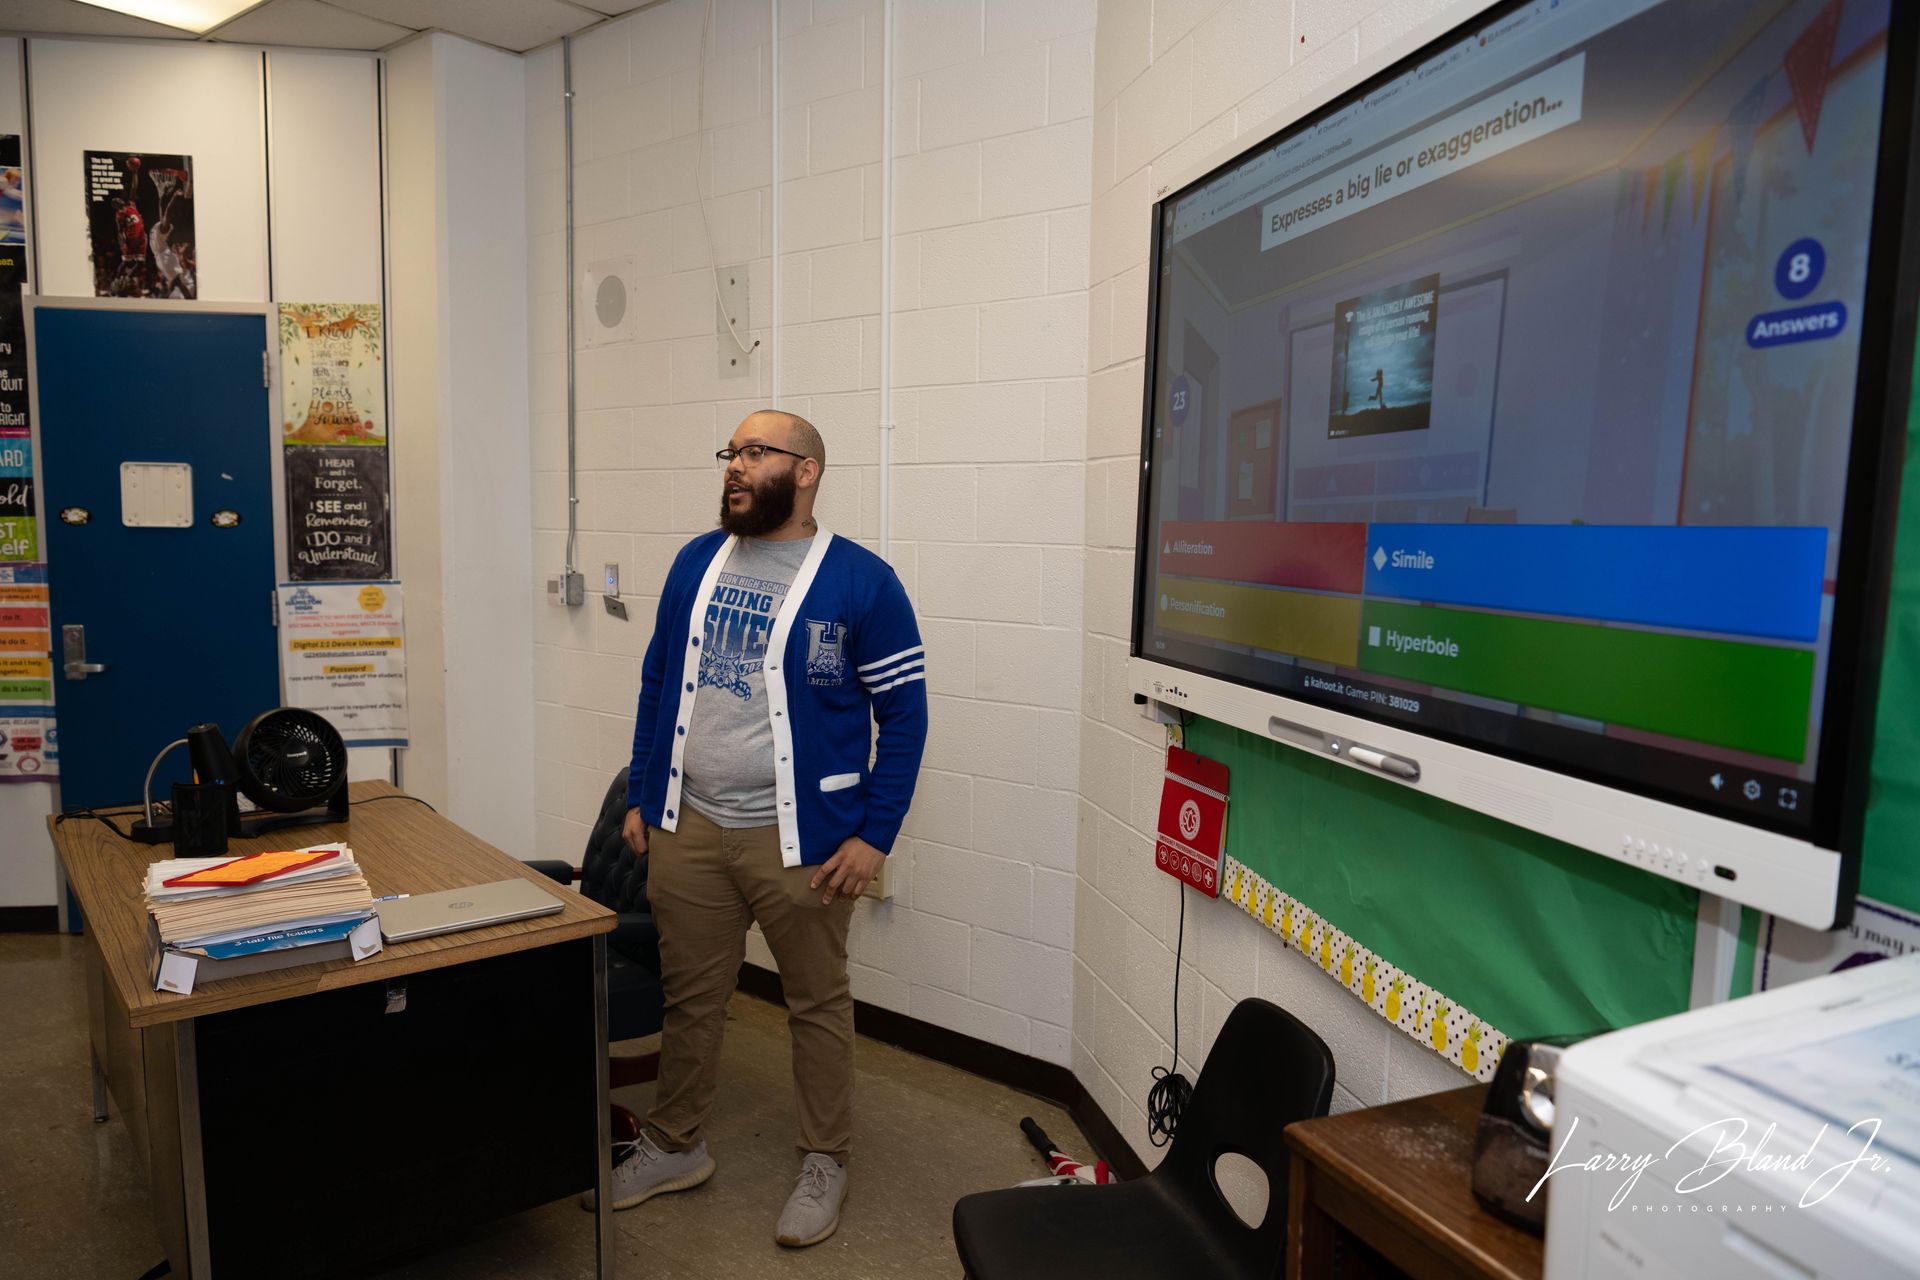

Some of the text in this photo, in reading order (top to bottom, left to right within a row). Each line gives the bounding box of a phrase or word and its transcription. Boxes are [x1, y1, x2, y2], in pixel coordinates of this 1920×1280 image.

[1271, 193, 1332, 233] Expresses
[1335, 188, 1343, 205] a
[1347, 173, 1370, 199] big
[1374, 163, 1392, 189] lie
[1396, 155, 1414, 178] or
[1417, 96, 1562, 169] exaggeration...
[1788, 253, 1811, 283] 8
[1752, 311, 1839, 340] Answers
[1, 378, 23, 391] QUIT
[1172, 391, 1186, 411] 23
[319, 459, 355, 468] I HEAR
[314, 476, 363, 492] Forget.
[310, 501, 314, 510] I
[316, 500, 342, 513] SEE
[344, 502, 363, 511] and
[305, 513, 373, 528] Remember.
[306, 535, 311, 546] I
[314, 531, 341, 547] DO
[344, 535, 363, 545] and
[1172, 540, 1214, 556] Alliteration
[297, 546, 380, 566] Understand.
[1391, 549, 1435, 570] Simile
[739, 577, 761, 590] HIGH
[710, 585, 774, 613] NDING
[1170, 598, 1225, 619] Personification
[332, 639, 357, 648] Device
[1386, 629, 1459, 658] Hyperbole
[1310, 676, 1419, 713] kahoot.it Game PIN: 381029
[267, 933, 285, 942] file
[286, 927, 324, 938] folders
